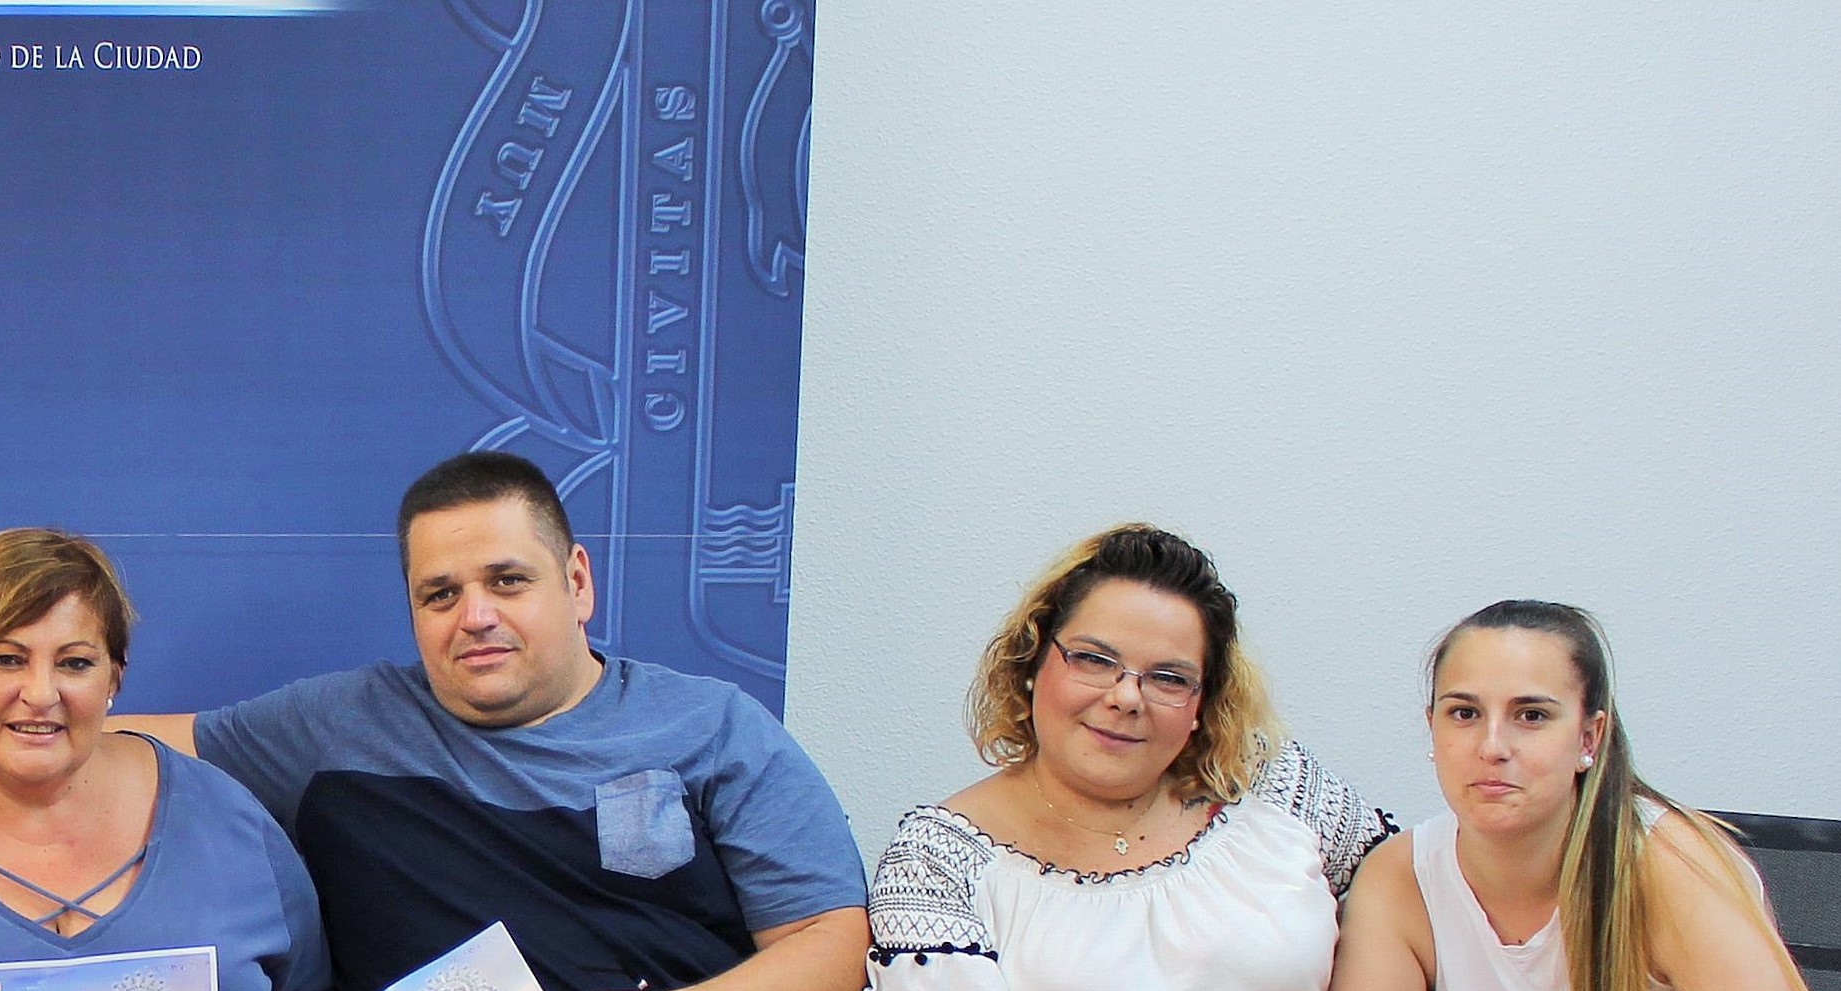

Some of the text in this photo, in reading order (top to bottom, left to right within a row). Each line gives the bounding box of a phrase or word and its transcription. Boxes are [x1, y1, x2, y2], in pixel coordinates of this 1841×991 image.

[11, 46, 44, 68] DE
[55, 46, 85, 69] LA
[94, 42, 202, 70] CIUDAD
[474, 76, 573, 238] MUY
[645, 85, 697, 431] CIVITAS
